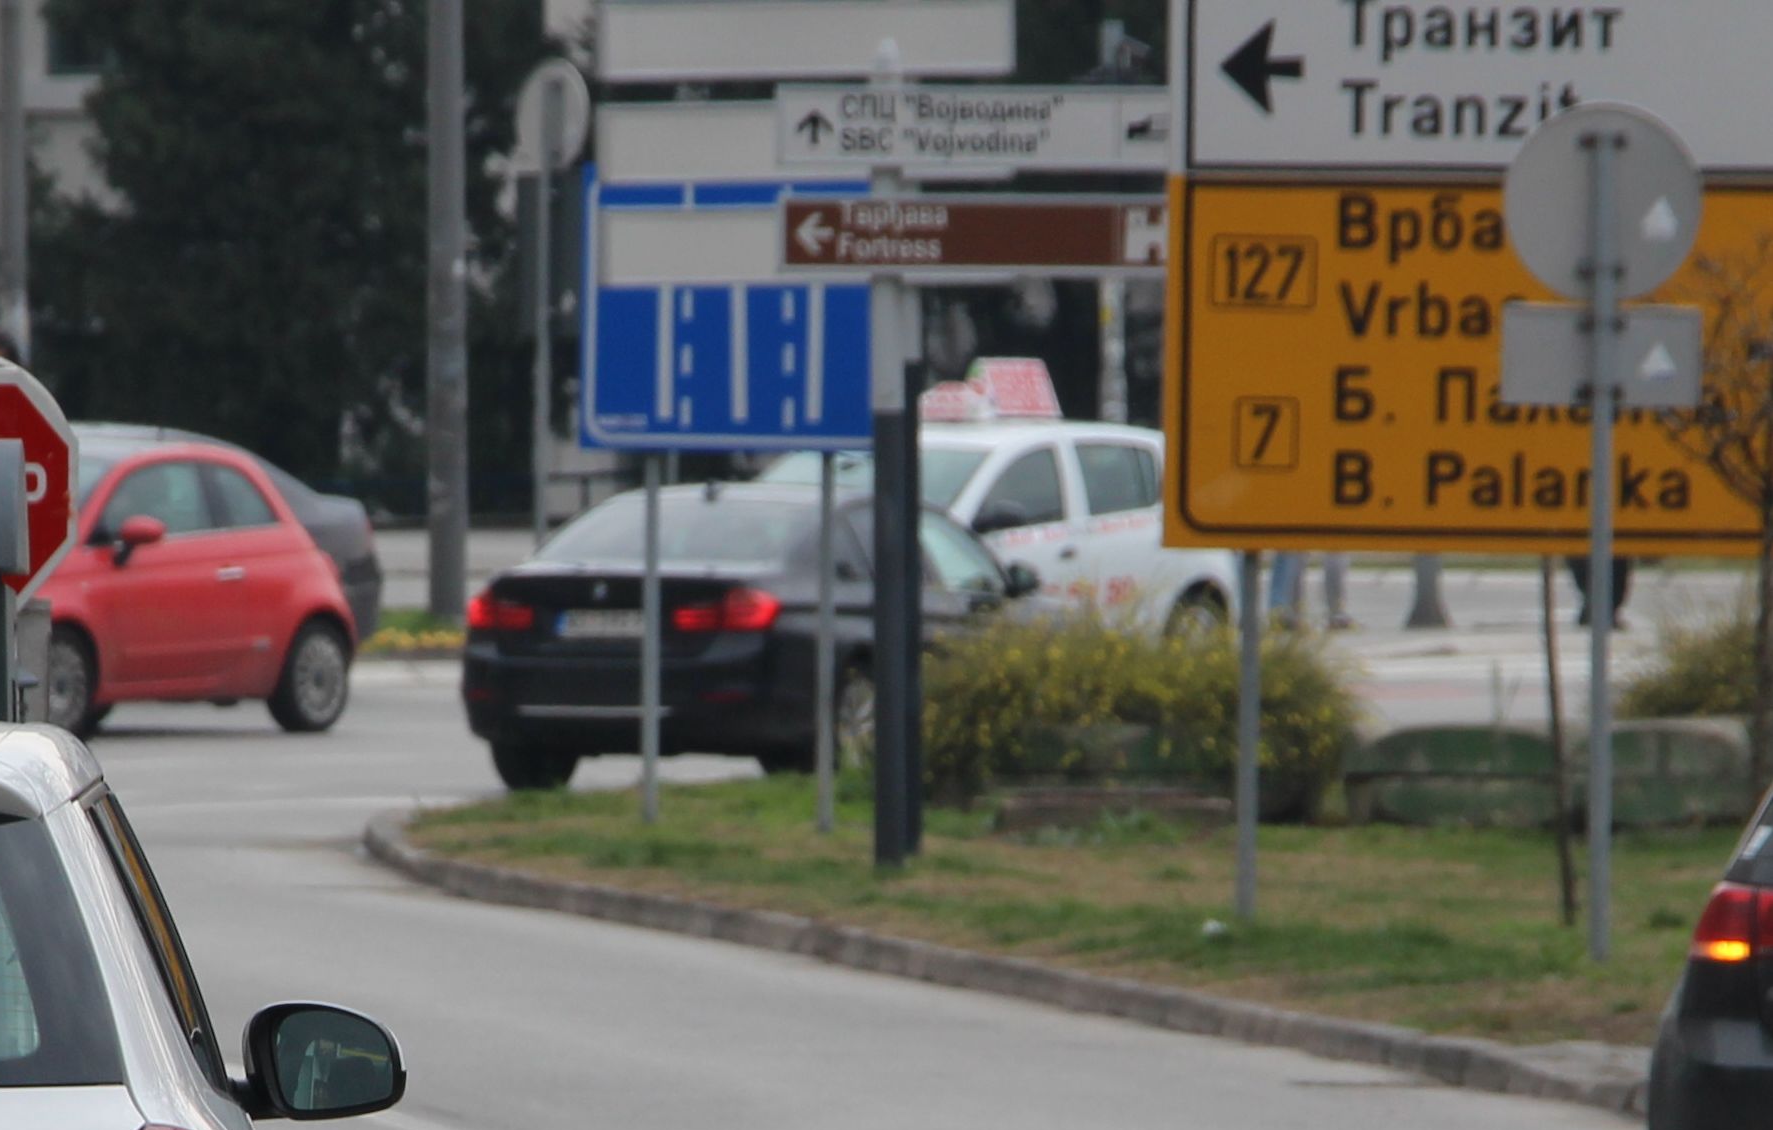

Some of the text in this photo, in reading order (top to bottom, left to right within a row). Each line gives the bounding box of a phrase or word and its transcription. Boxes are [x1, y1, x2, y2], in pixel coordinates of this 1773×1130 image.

[1341, 0, 1622, 62] Транзит
[837, 231, 943, 260] Fortress
[1339, 193, 1504, 264] Врба
[1225, 244, 1306, 301] 127
[1339, 281, 1526, 338] Vrba
[1333, 365, 1396, 424] Б.
[1252, 402, 1282, 460] 7
[1333, 452, 1394, 507] B.
